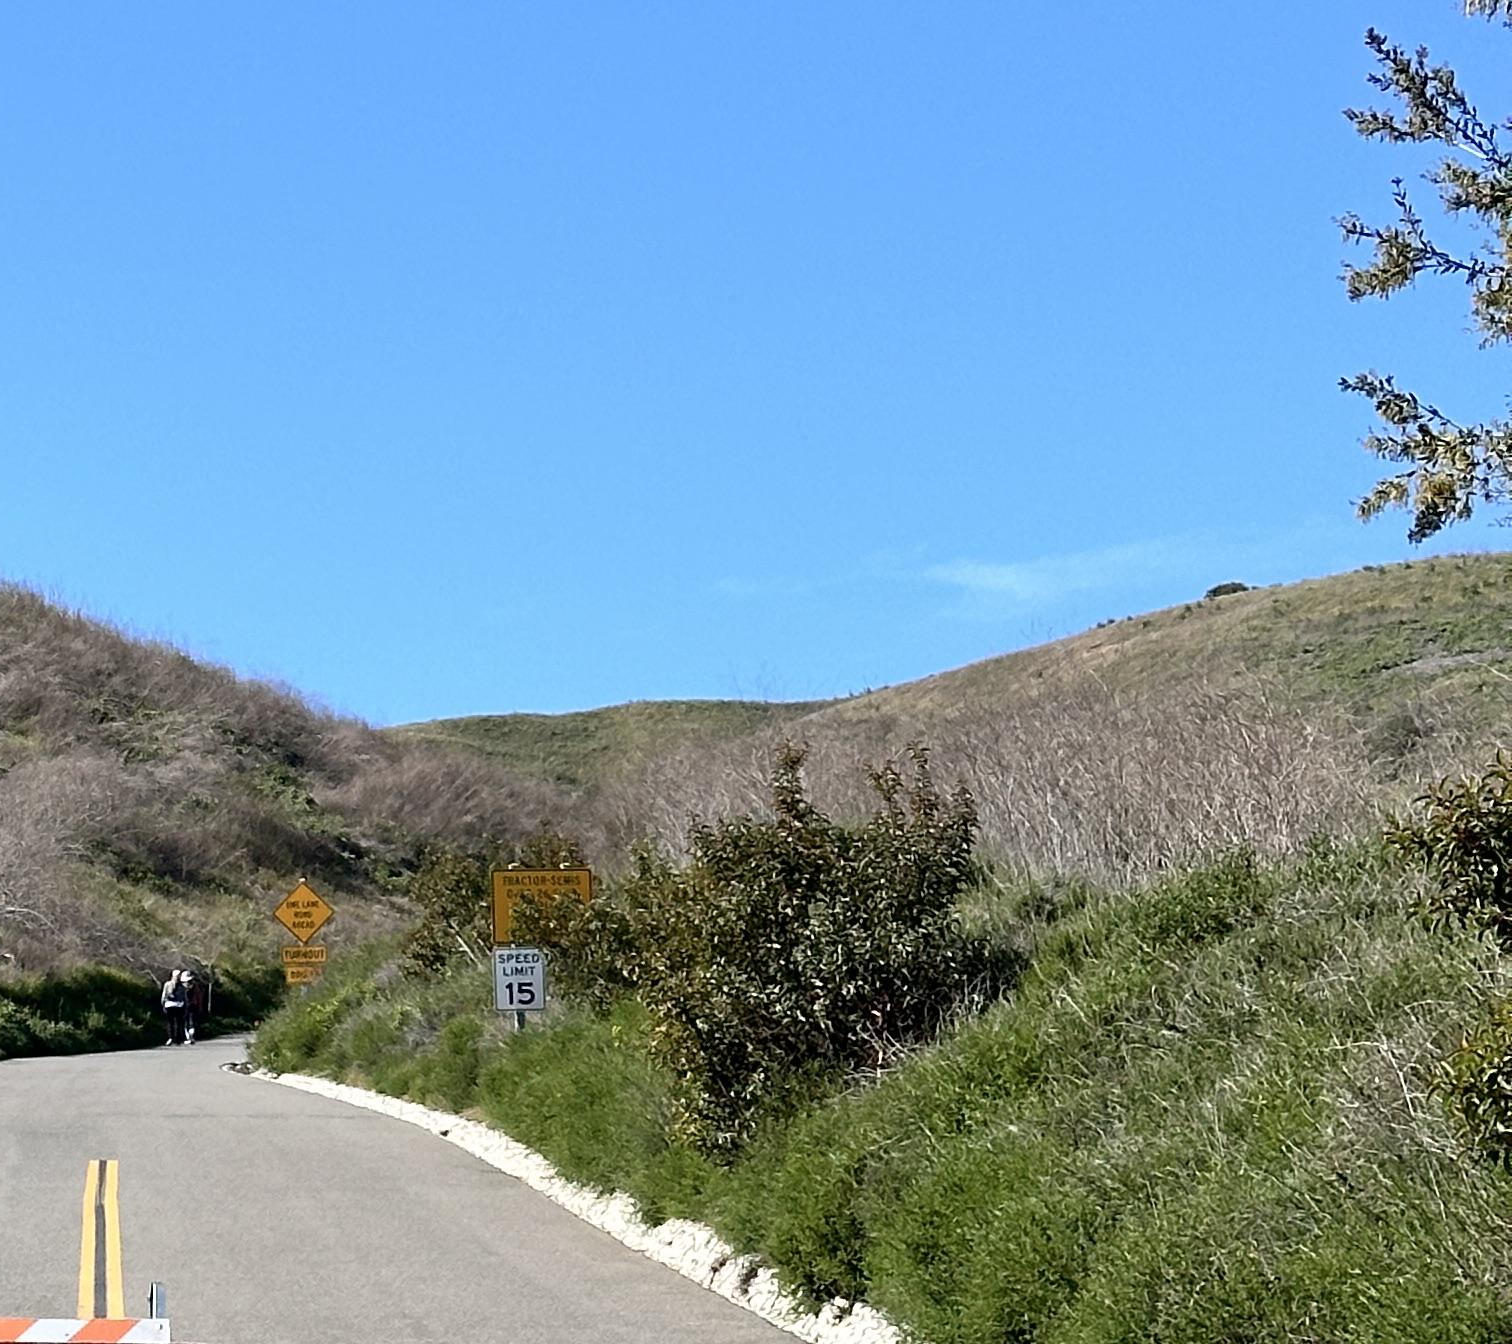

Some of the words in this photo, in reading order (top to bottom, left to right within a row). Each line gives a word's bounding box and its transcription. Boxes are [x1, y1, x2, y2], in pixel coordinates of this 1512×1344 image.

[498, 953, 540, 964] SPEED
[503, 966, 535, 977] LIMIT
[505, 982, 535, 1005] 15
